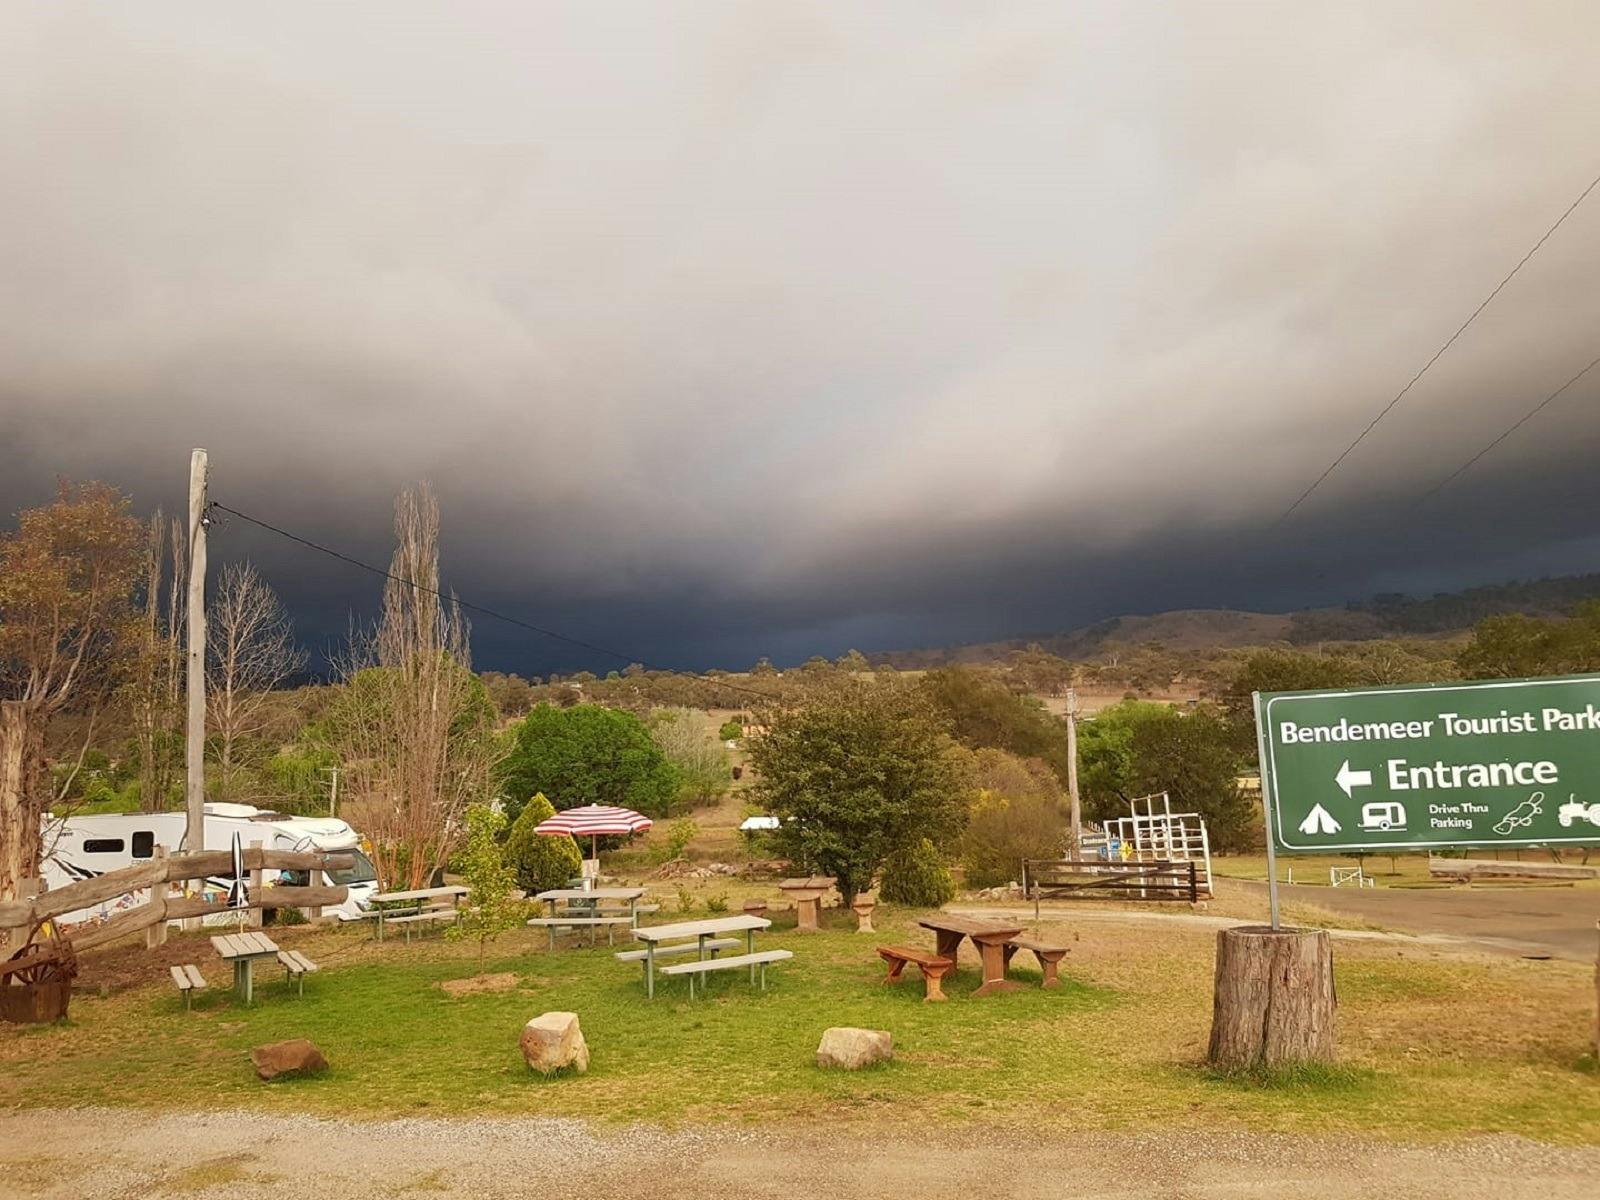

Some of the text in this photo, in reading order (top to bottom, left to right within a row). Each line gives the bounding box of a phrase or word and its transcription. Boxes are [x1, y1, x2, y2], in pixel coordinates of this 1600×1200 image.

[1280, 703, 1600, 744] Bendemeer Tourist Park
[1387, 759, 1558, 790] Entrance
[1429, 802, 1489, 814] Drive Thru
[1430, 816, 1473, 830] Parking
